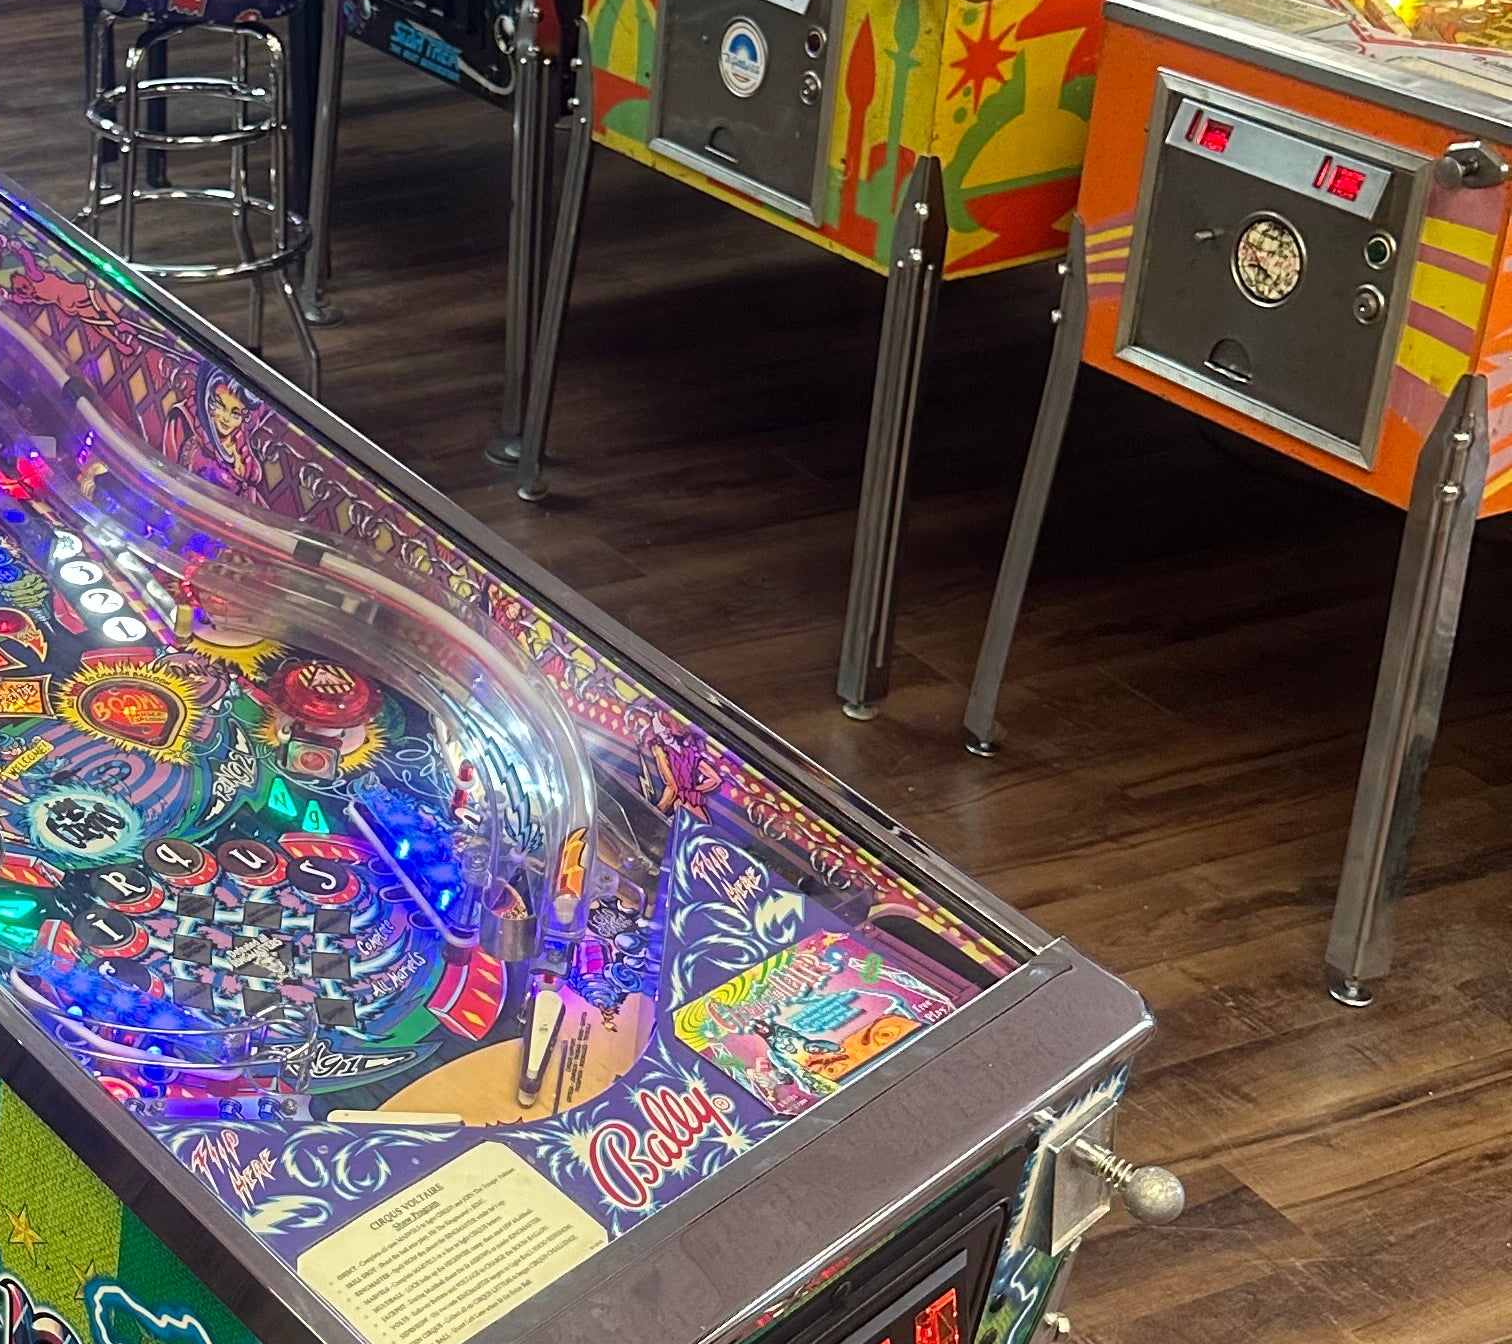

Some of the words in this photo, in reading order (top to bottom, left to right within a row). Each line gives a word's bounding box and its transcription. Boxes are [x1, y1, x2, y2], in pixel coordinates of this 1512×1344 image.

[93, 691, 161, 722] BOOM!
[9, 739, 49, 779] WELCOME!
[589, 1084, 733, 1209] Bally
[367, 1206, 404, 1231] CIRQUS
[399, 1181, 445, 1212] VOLTAIRE
[391, 1215, 414, 1231] Show
